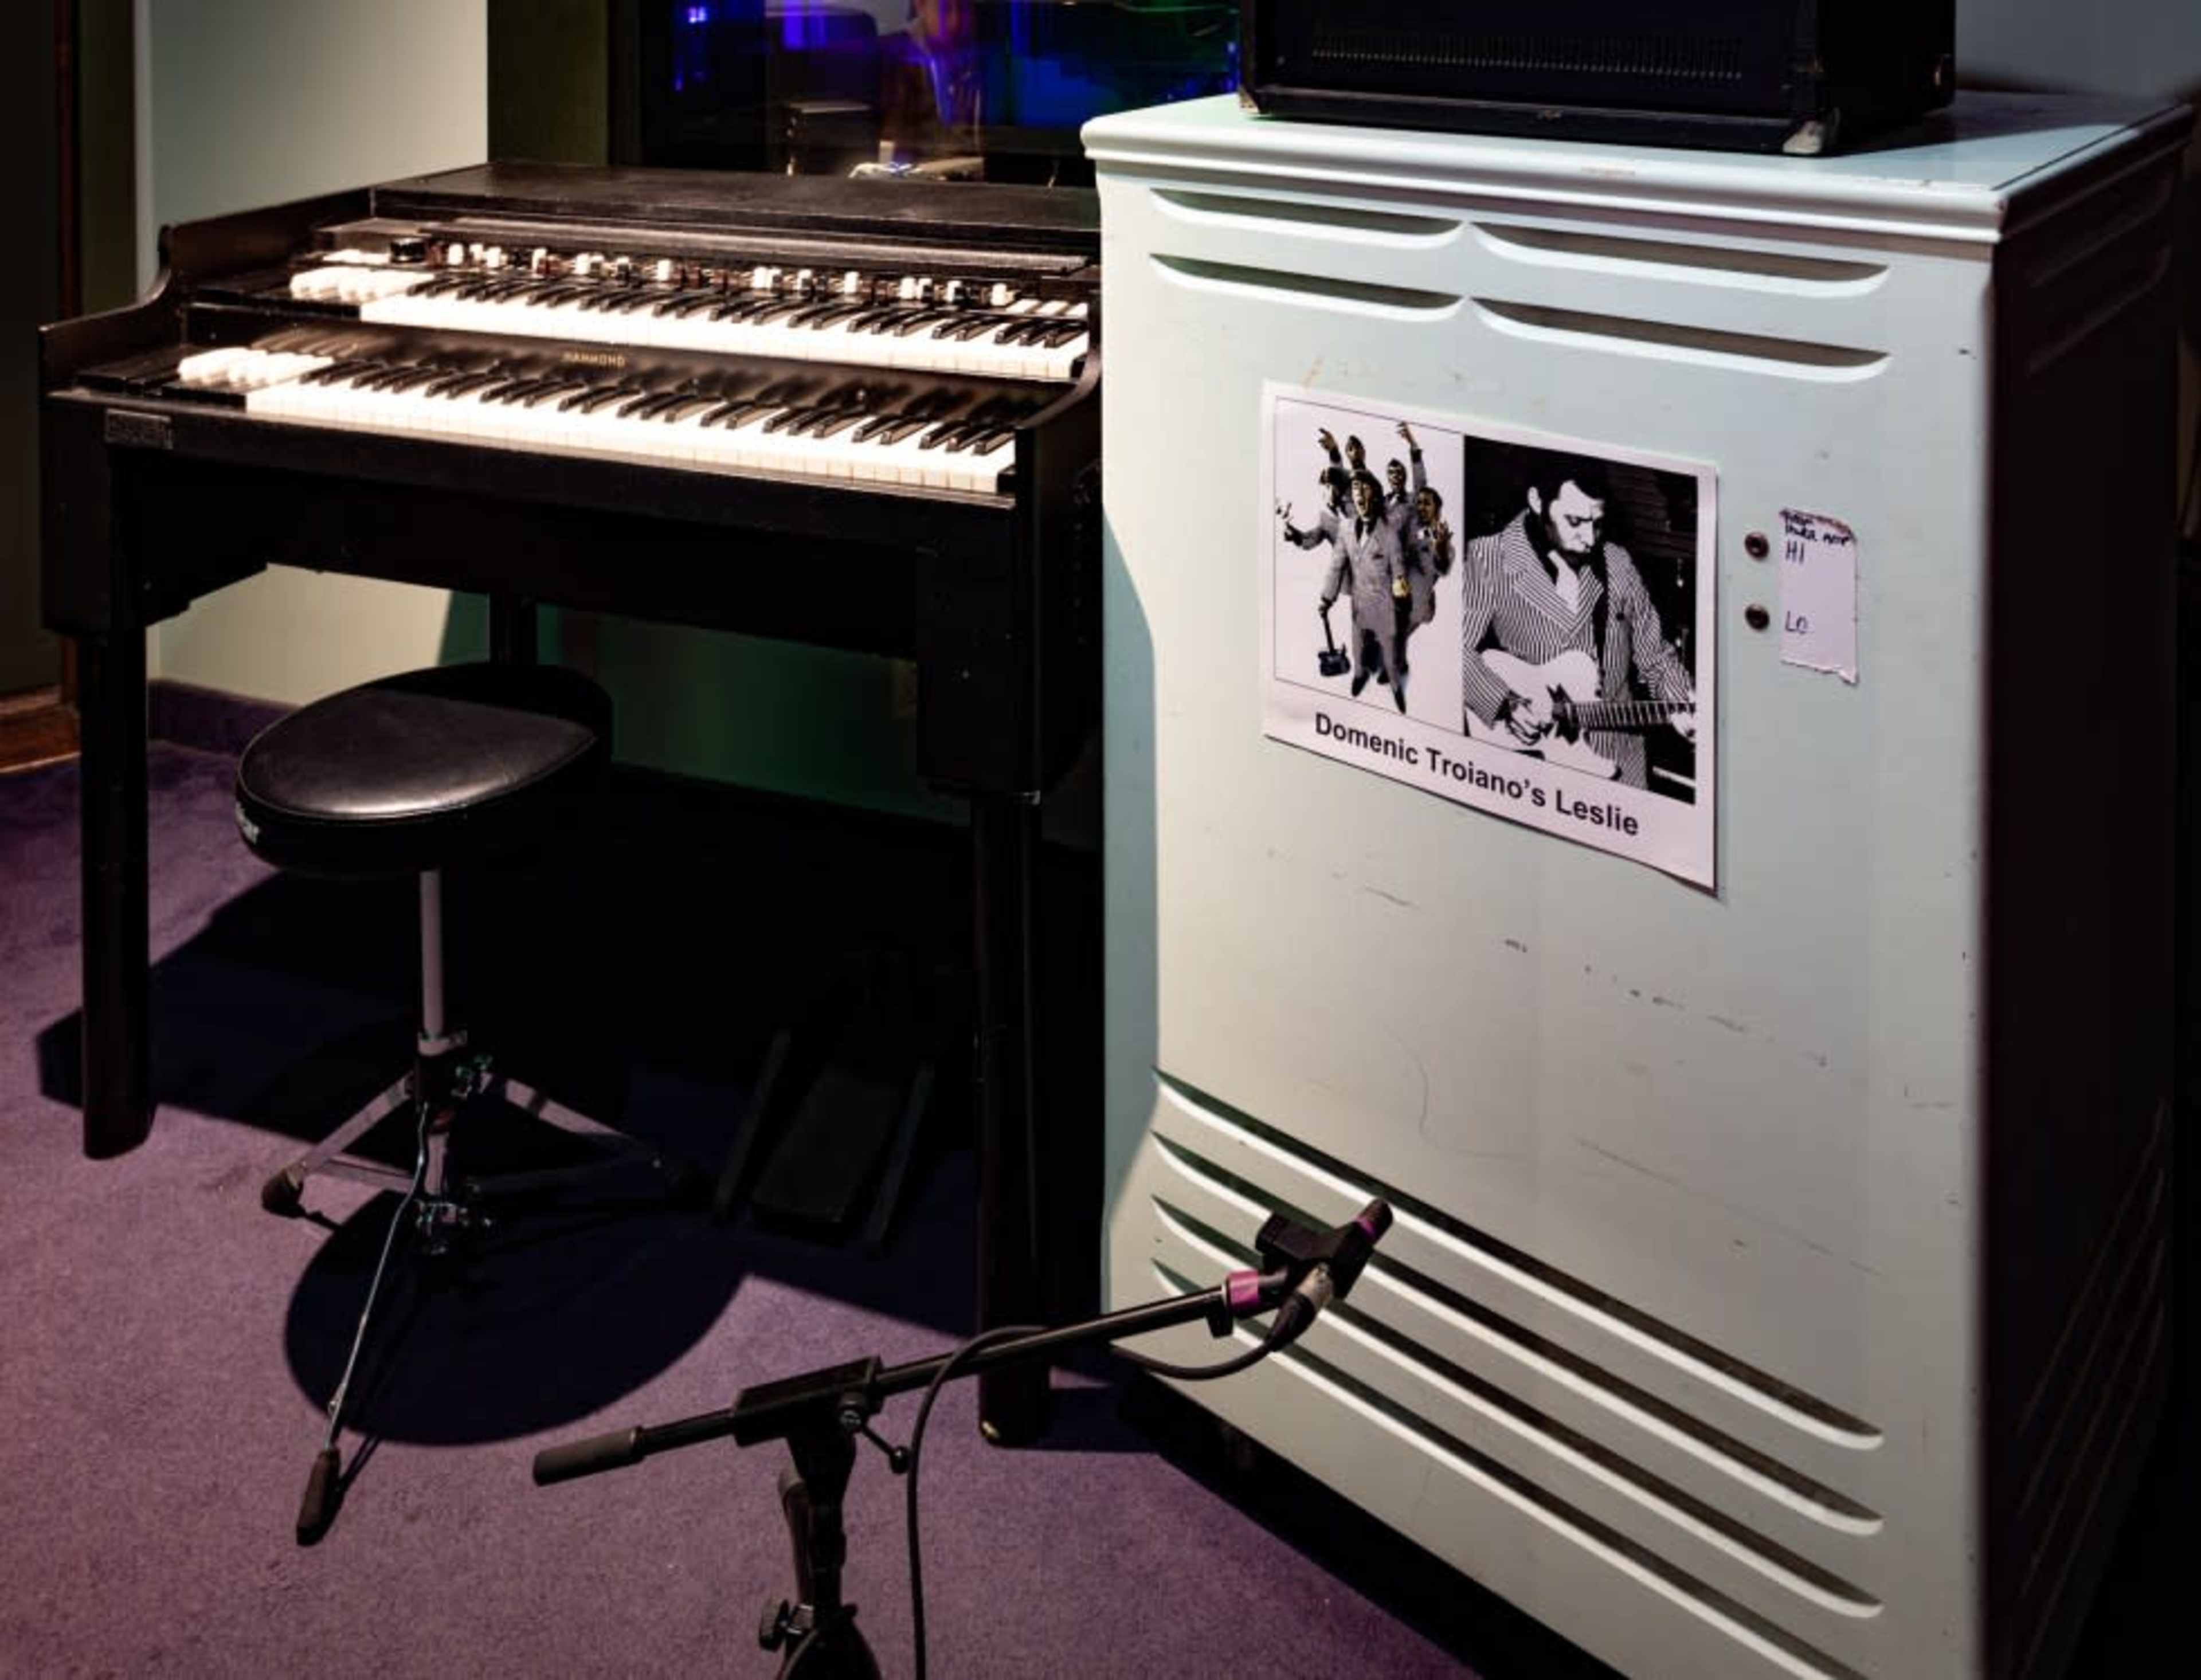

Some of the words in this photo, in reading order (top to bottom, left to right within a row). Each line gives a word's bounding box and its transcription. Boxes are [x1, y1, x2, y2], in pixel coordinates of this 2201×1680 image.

[1315, 712, 1418, 765] Domenic
[1426, 747, 1546, 807] Troiano’s
[1556, 789, 1638, 836] Leslie
